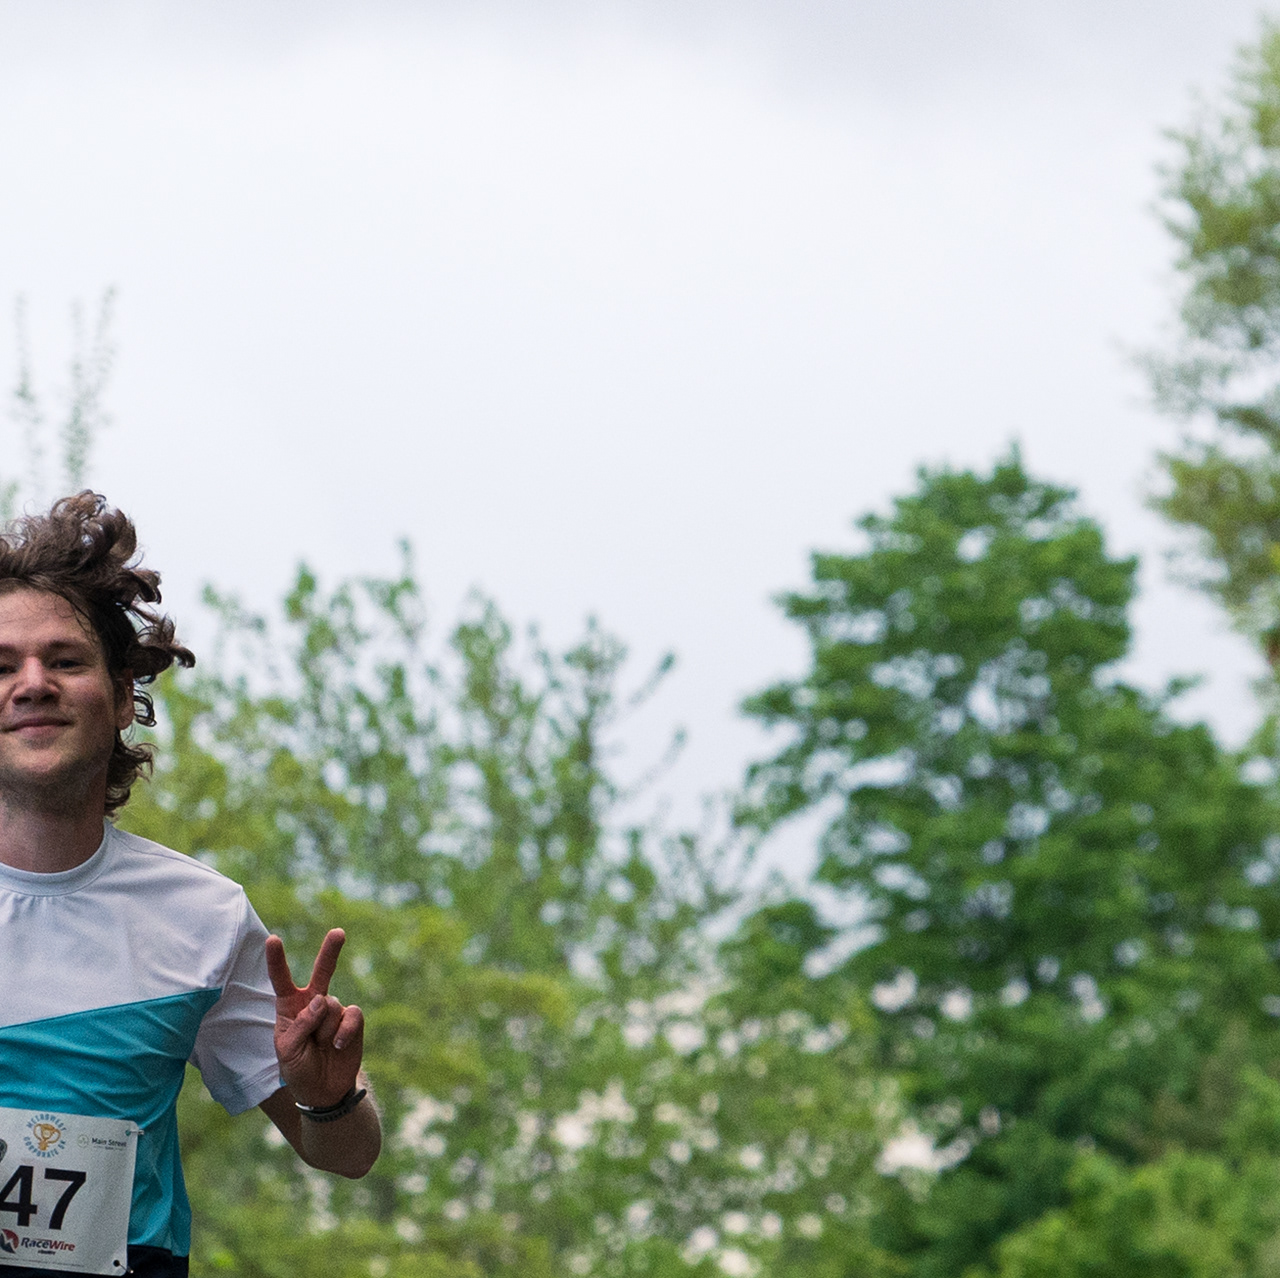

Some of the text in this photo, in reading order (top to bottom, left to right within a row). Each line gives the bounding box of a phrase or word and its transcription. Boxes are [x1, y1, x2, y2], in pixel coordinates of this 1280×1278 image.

[23, 1136, 59, 1158] CORPORATE
[91, 1137, 107, 1145] Main
[20, 1237, 76, 1252] RaceWire
